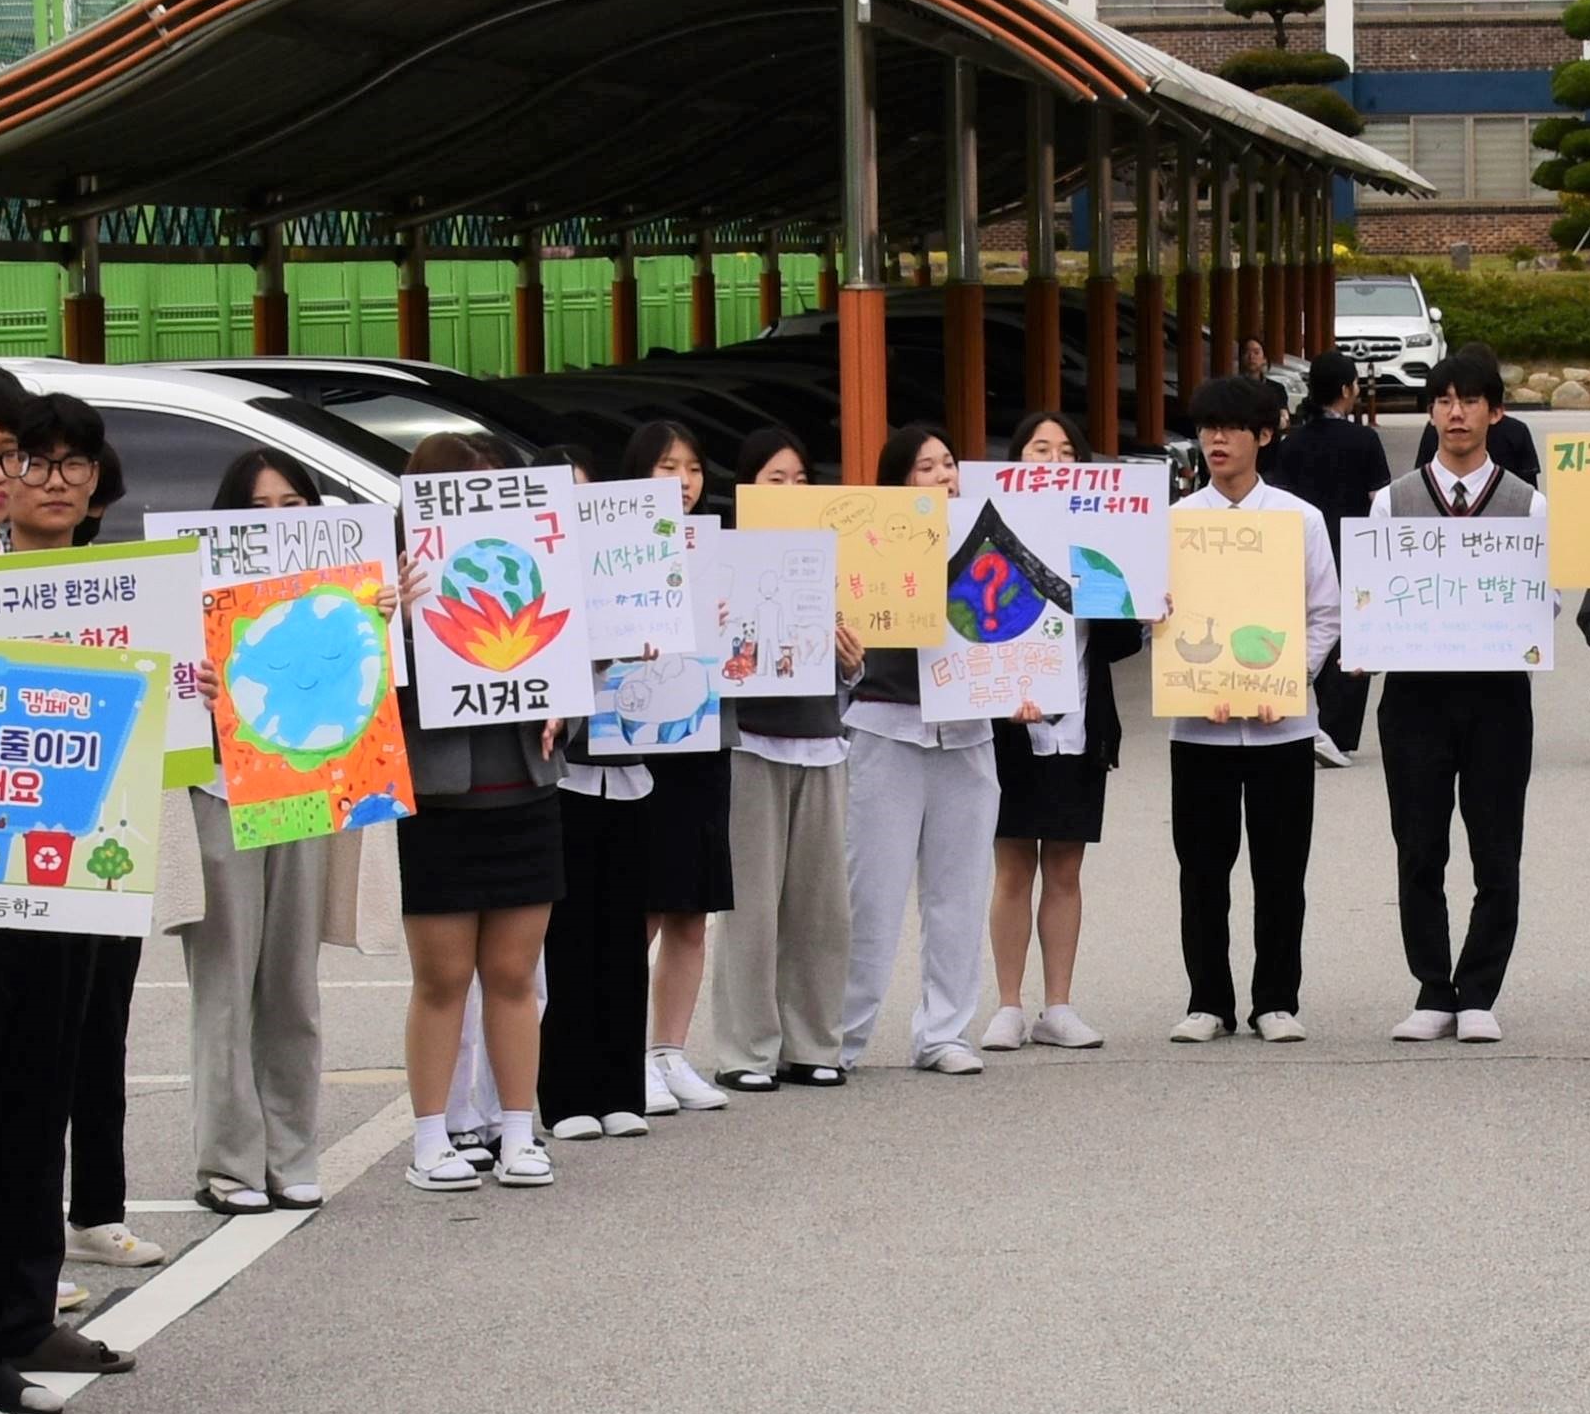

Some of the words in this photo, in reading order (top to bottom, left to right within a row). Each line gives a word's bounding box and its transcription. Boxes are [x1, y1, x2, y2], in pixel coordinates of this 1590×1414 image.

[413, 474, 549, 513] 불타오르는
[995, 466, 1123, 494] 기후위기!
[577, 493, 658, 526] 비상대응
[1068, 495, 1100, 514] 두의
[1103, 495, 1153, 514] 위기
[277, 518, 364, 573] WAR
[413, 525, 444, 562] 지
[533, 512, 566, 557] 구
[1354, 523, 1448, 561] 기후야
[1461, 530, 1546, 559] 변하지마
[593, 540, 680, 577] 시작해요
[64, 574, 137, 607] 환경사랑
[901, 571, 918, 597] 봄
[1384, 572, 1469, 617] 우리가
[203, 589, 238, 617] 우리
[18, 689, 92, 718] 캠페인
[451, 677, 551, 718] 지켜요
[0, 730, 99, 768] 줄이기
